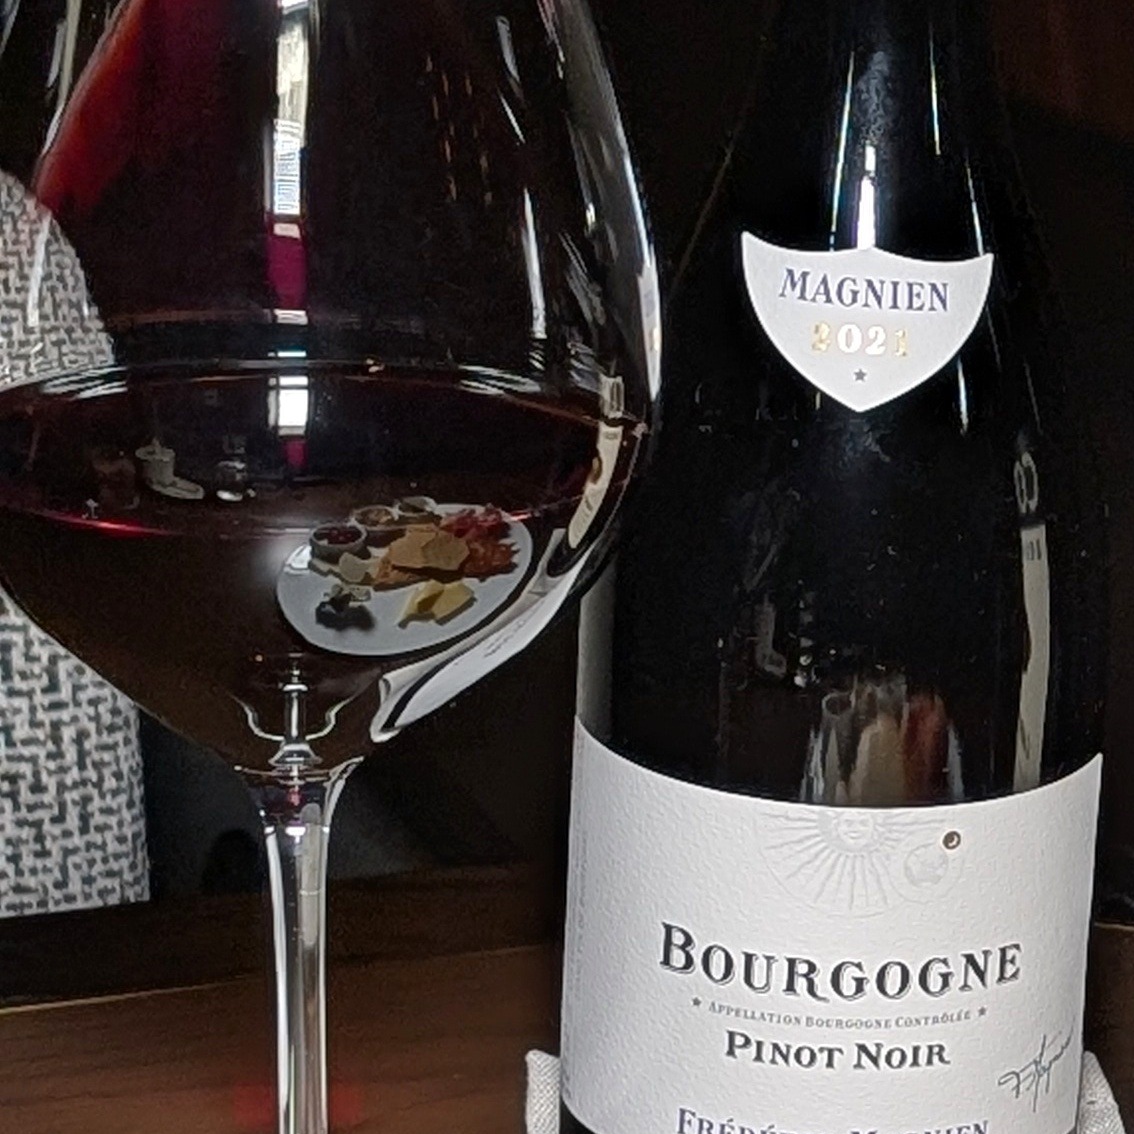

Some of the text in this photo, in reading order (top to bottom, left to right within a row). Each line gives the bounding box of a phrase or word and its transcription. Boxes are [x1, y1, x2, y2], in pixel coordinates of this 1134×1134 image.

[778, 268, 949, 312] MAGNIEN
[811, 322, 909, 357] 2021
[659, 920, 1022, 1003] BOURGOGNE
[708, 1001, 971, 1029] APPELLATION BOURGOGNE CONTRÔLÉE
[724, 1029, 951, 1069] PINOT NOIR
